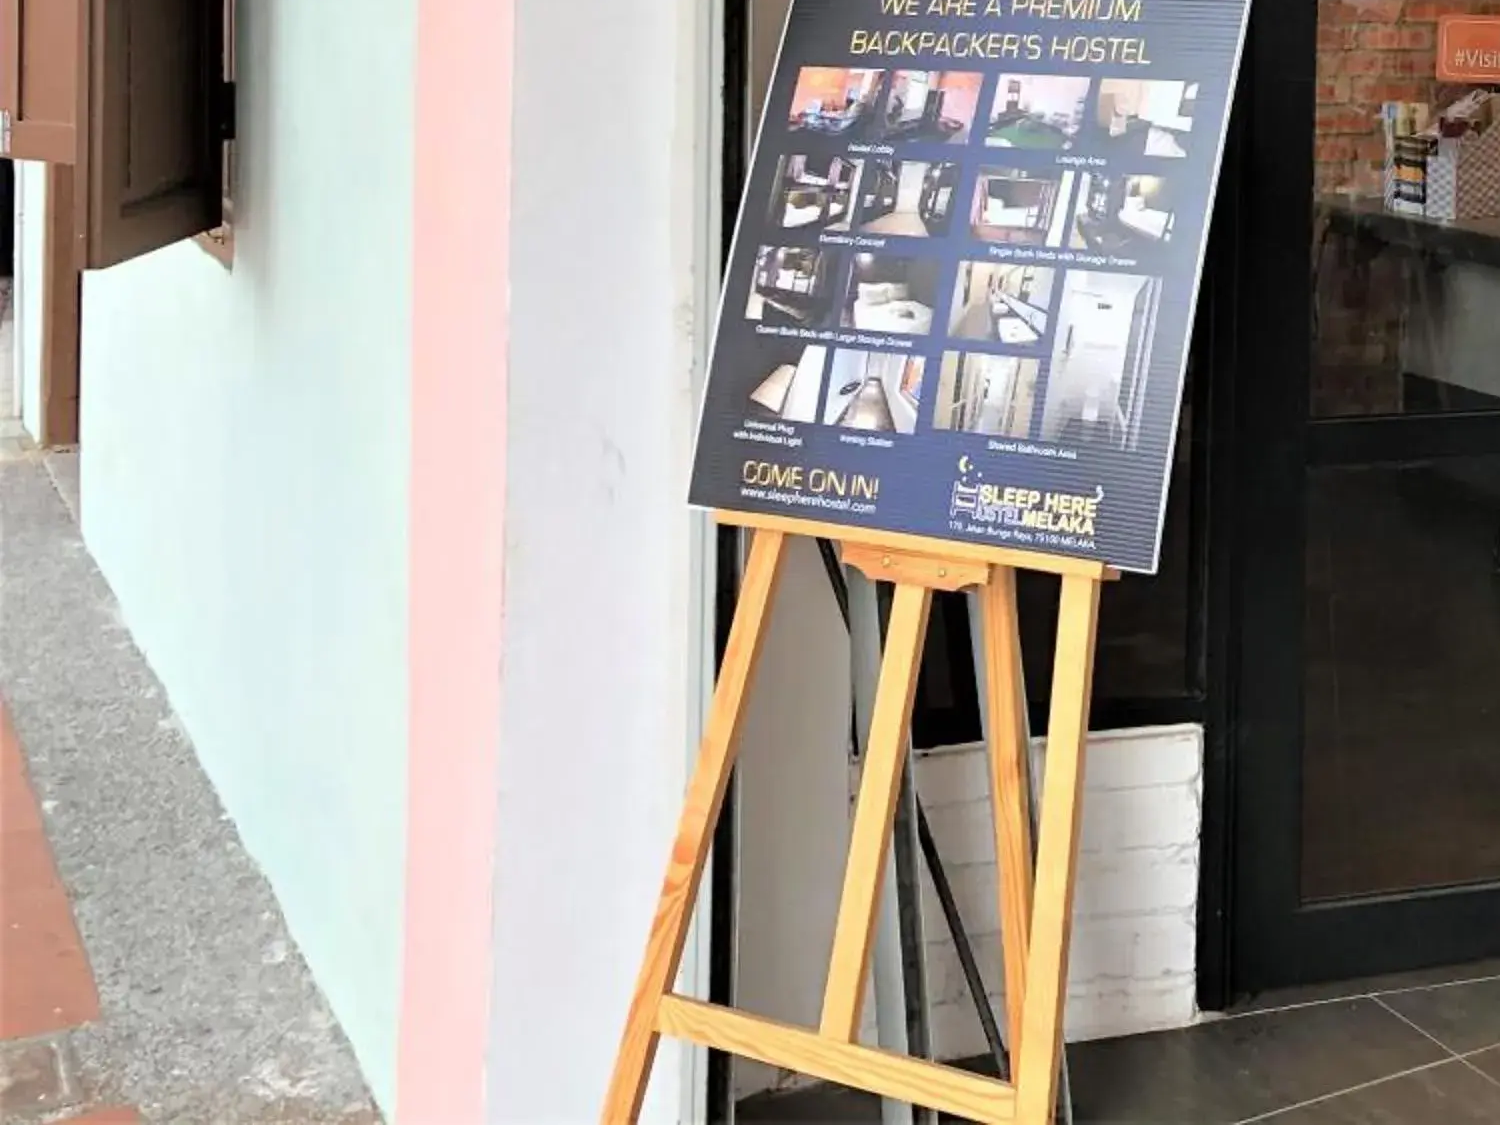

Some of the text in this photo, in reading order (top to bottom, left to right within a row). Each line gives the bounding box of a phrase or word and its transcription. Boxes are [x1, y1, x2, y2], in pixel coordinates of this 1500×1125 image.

[849, 29, 1154, 65] BACKPACKER'S HOSTEL
[742, 460, 880, 501] COME ON IN!
[979, 483, 1097, 518] SLEEP HERE
[1022, 509, 1095, 536] MELAKA
